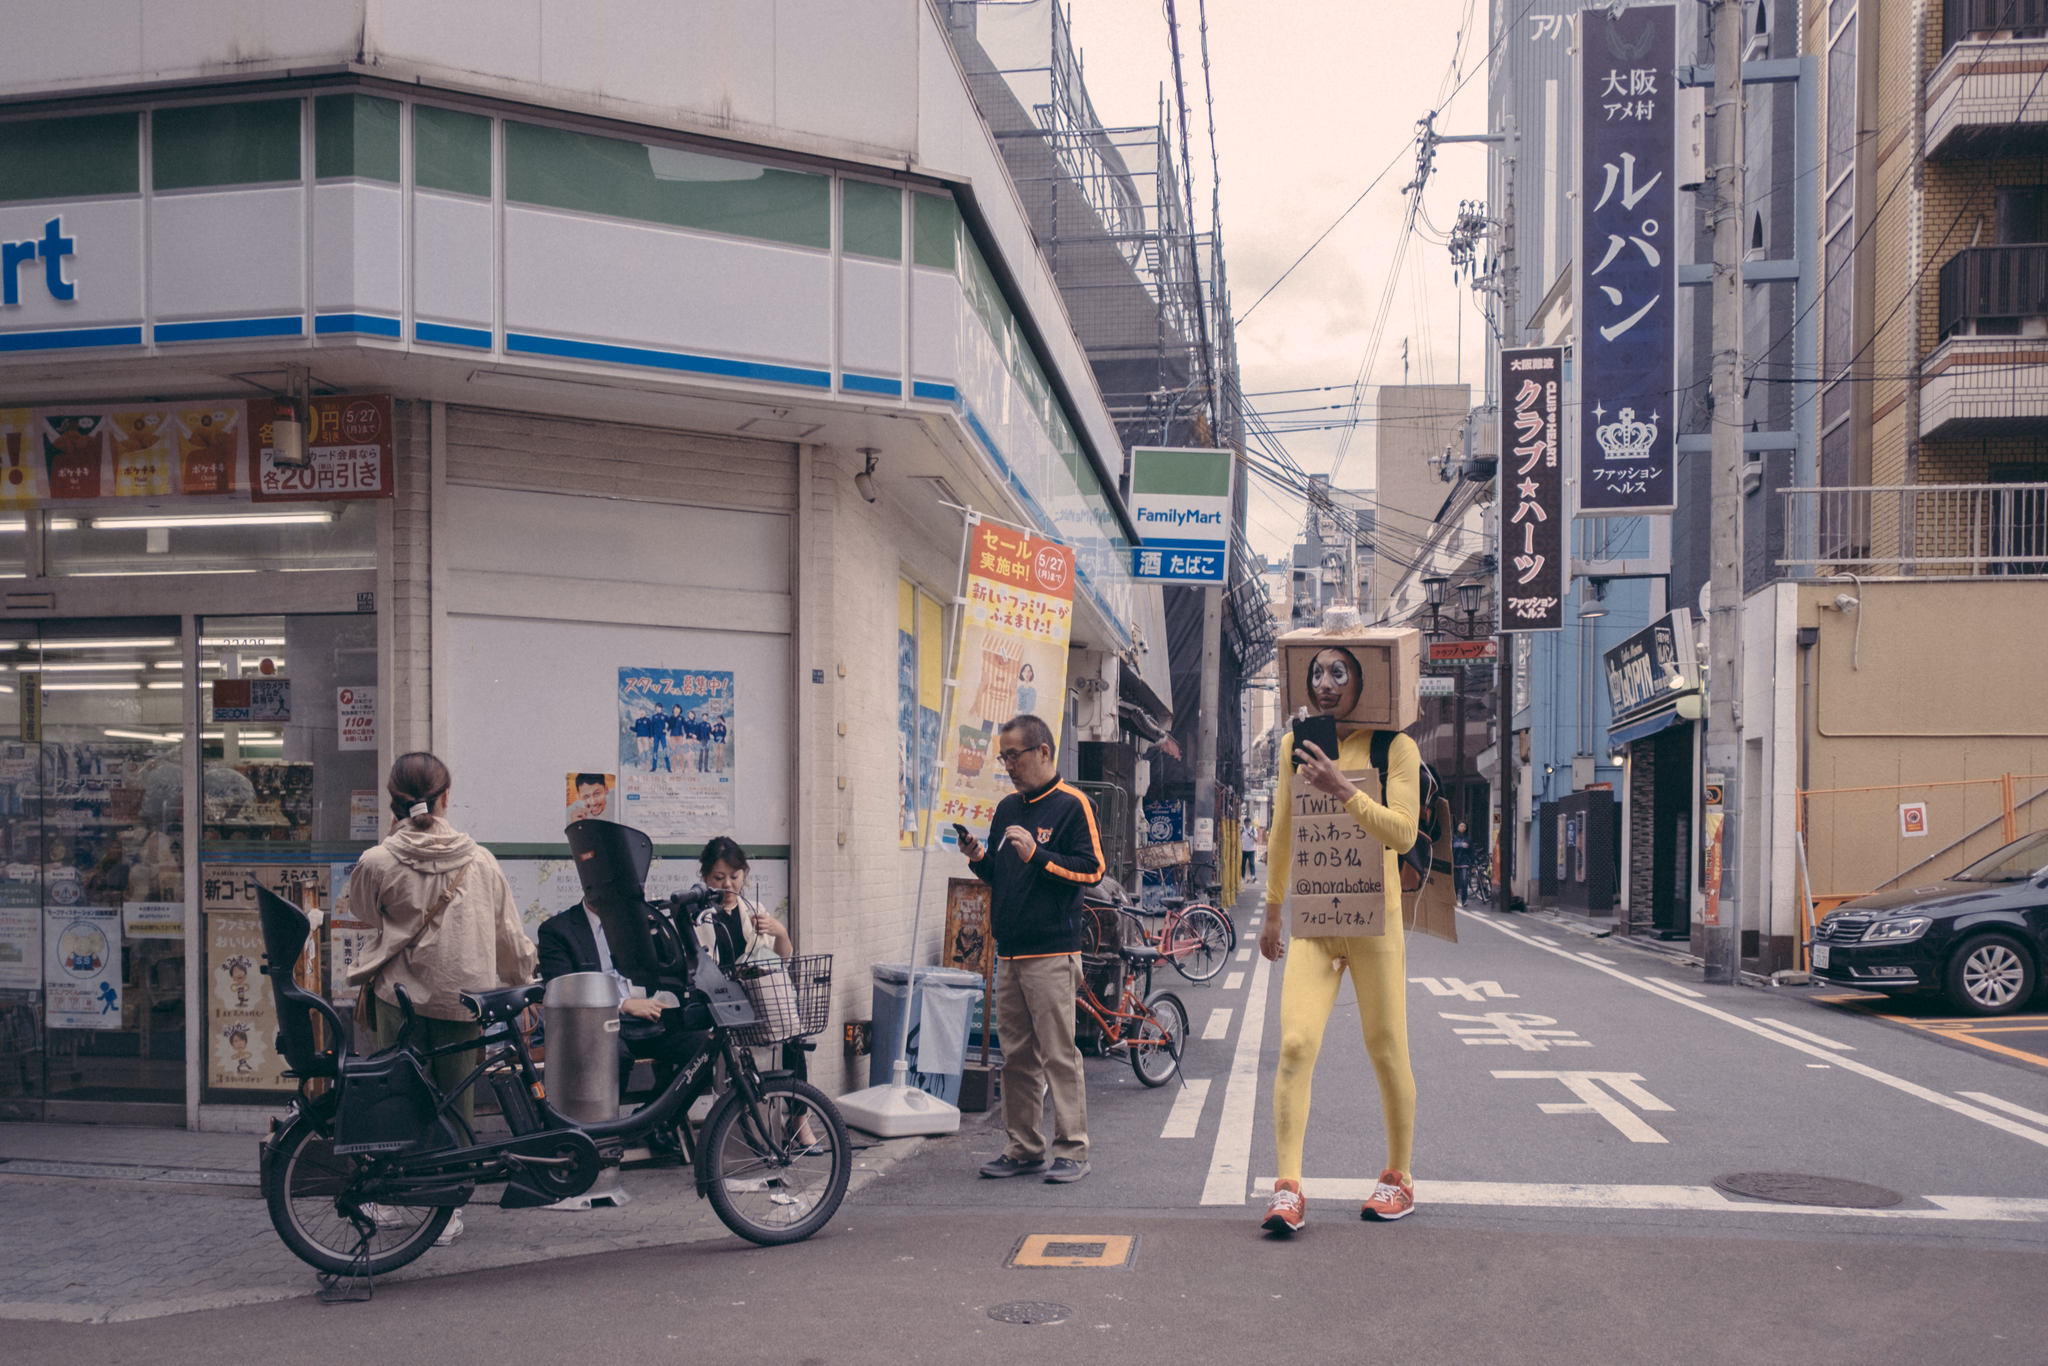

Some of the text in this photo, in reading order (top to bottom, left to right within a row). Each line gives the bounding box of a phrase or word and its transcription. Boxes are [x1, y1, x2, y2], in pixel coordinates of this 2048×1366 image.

[1601, 68, 1657, 97] 大阪
[1603, 100, 1655, 121] アメ村
[1591, 152, 1662, 341] ルパン
[346, 409, 376, 423] 5/27
[1546, 381, 1557, 467] CLUB HEARTS
[124, 464, 156, 475] ポケチキ
[1592, 467, 1663, 481] ファッション
[1511, 379, 1547, 584] クラブ ハーツ
[1607, 481, 1647, 494] ヘルス
[1137, 508, 1221, 526] FamilyMart
[983, 529, 1032, 559] セール
[980, 552, 1030, 582] 実施中!
[1038, 554, 1063, 572] 5/27
[1139, 551, 1215, 575] 酒 たばこ
[1038, 569, 1062, 583] (月)まで
[972, 582, 1070, 619] 新しいファミリーが
[1508, 597, 1558, 609] ファッション
[989, 608, 1052, 635] ふえました!
[1516, 607, 1547, 619] ヘルス
[252, 681, 290, 690] 防犯カメラで
[1618, 652, 1655, 708] LUPIN
[252, 689, 279, 697] セコムが
[214, 708, 249, 719] SECOM
[943, 799, 995, 822] ポケチキ
[1296, 794, 1346, 814] Twit
[1150, 815, 1172, 824] COFFEE
[1296, 877, 1382, 896] @norabotoke
[1301, 911, 1374, 925] フォローしてね!
[344, 939, 353, 966] 販売中
